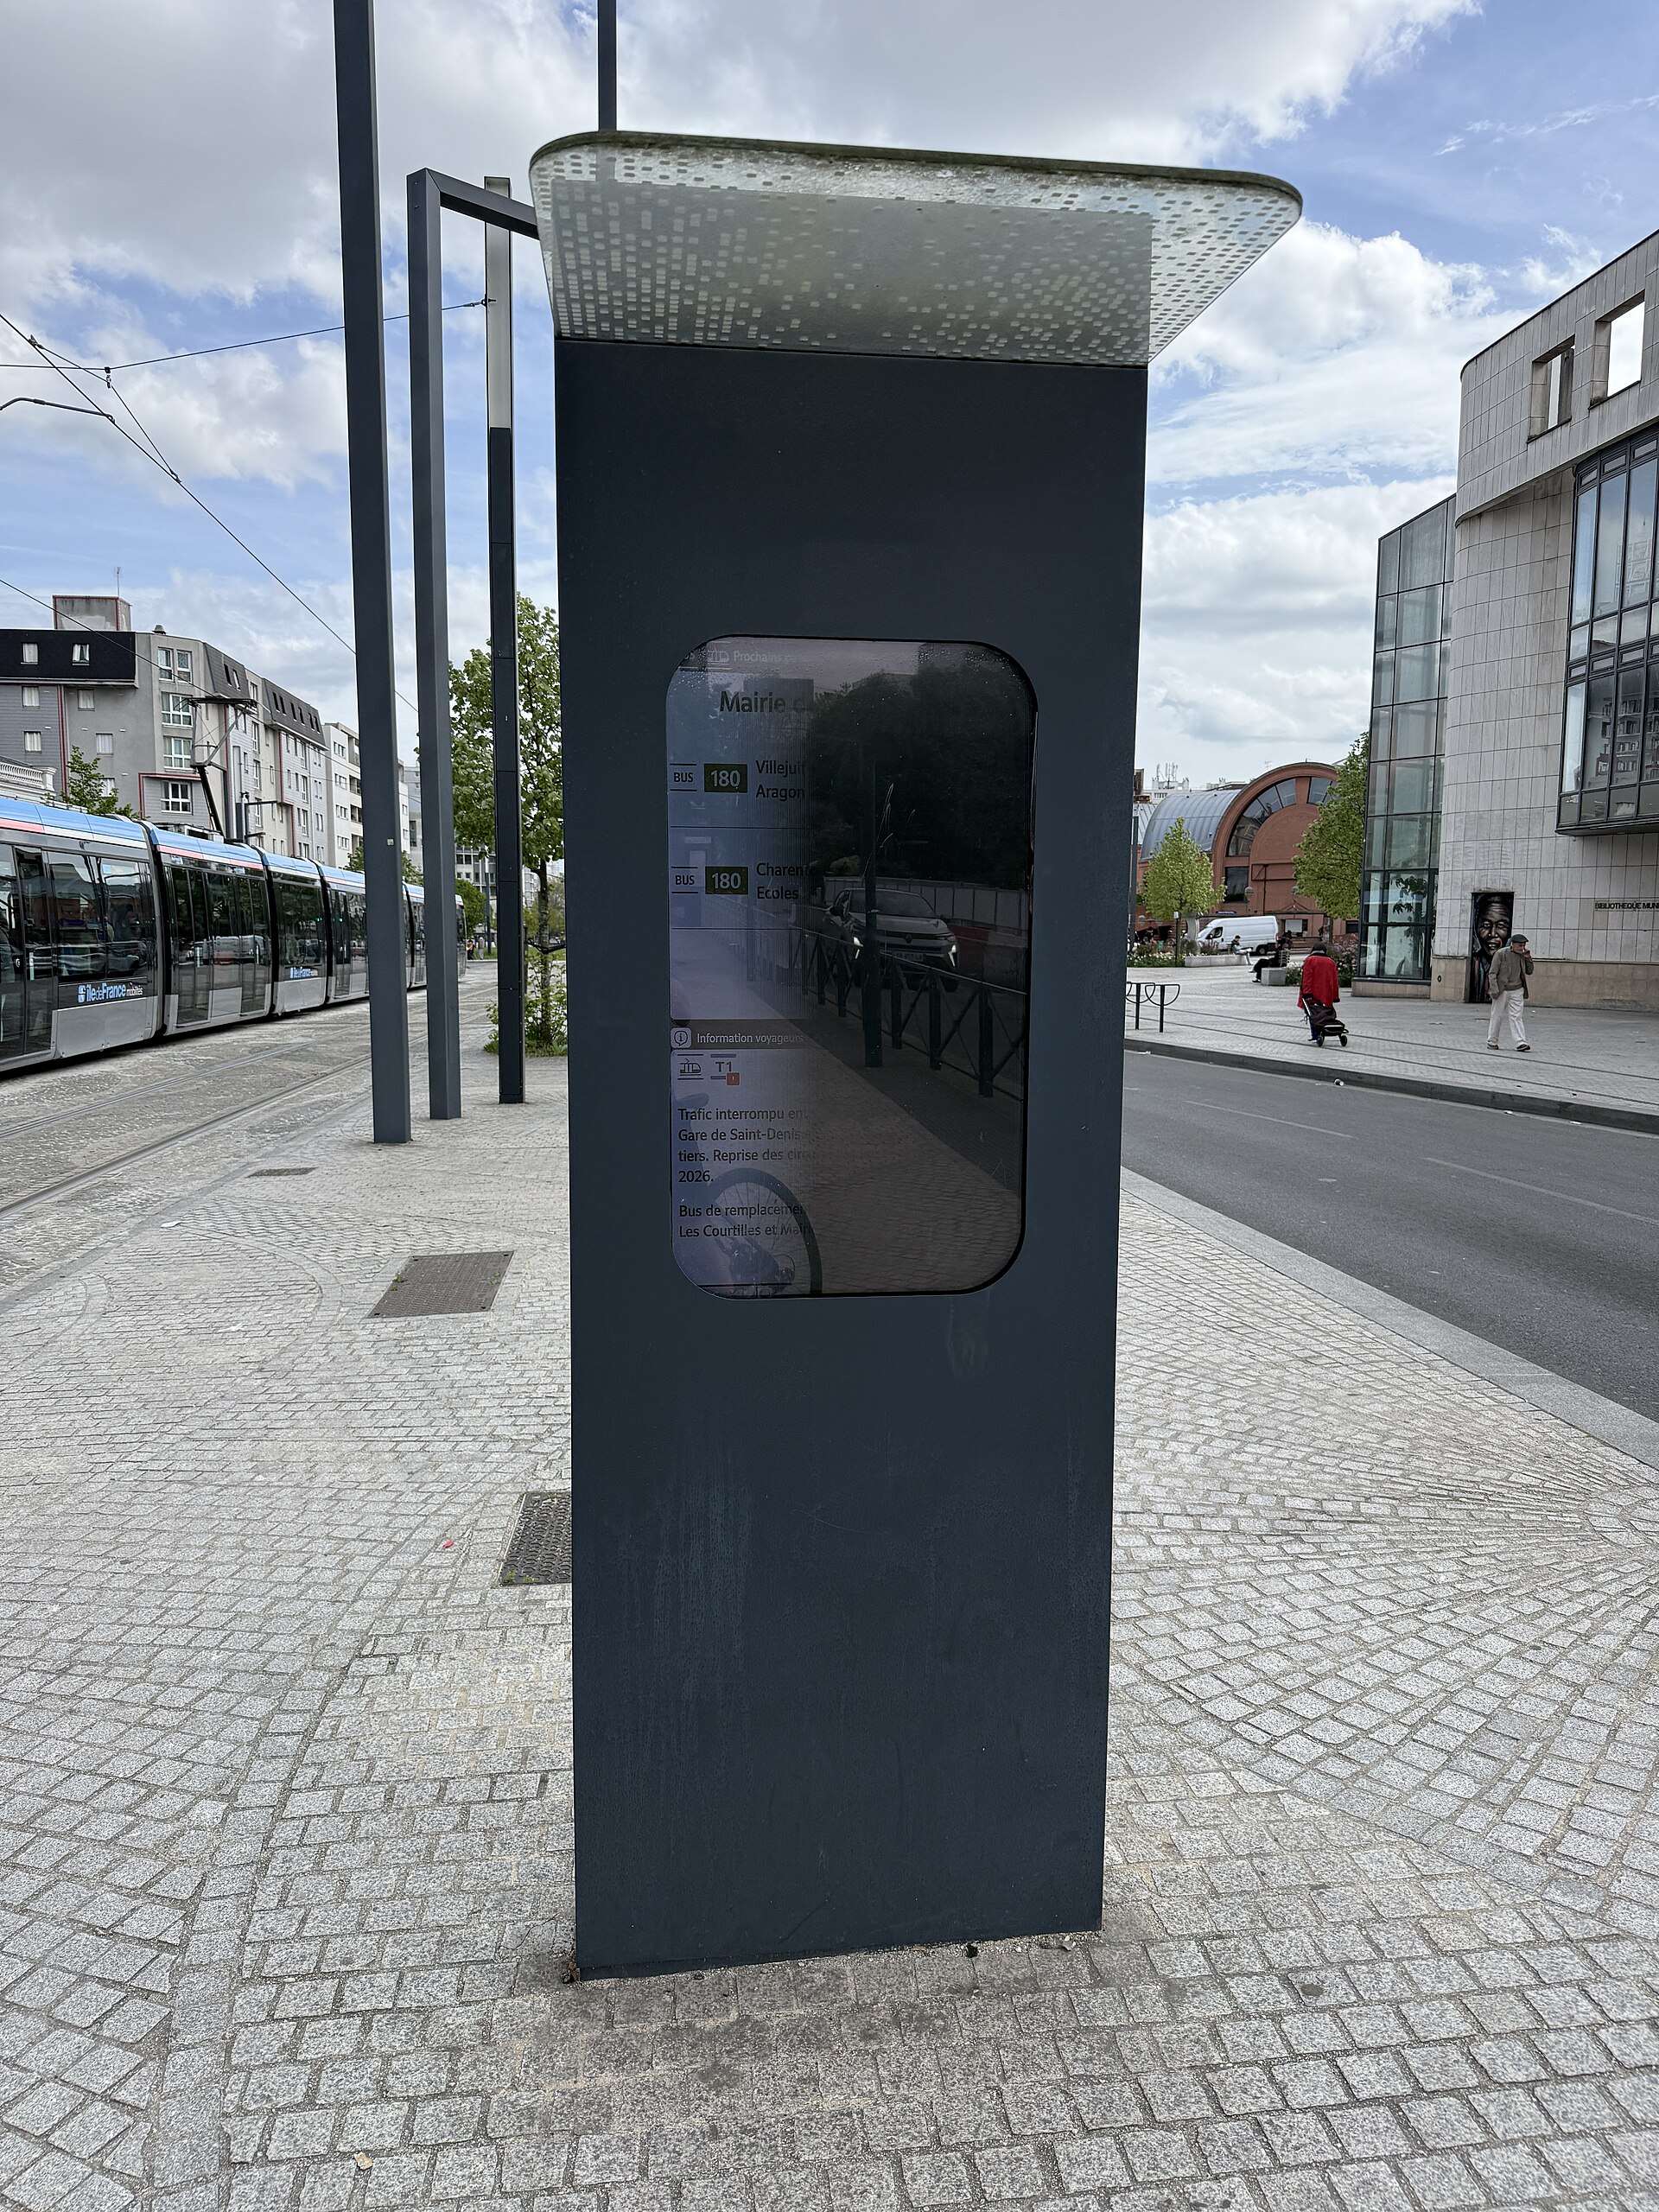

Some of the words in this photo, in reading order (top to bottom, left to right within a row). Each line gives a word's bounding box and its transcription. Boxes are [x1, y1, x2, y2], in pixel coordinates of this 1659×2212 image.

[720, 690, 785, 713] Mairie
[673, 772, 694, 783] BUS
[710, 770, 741, 787] 180
[755, 784, 805, 801] Aragon
[675, 875, 695, 885] BUS
[712, 873, 741, 888] 180
[757, 887, 799, 899] Ecoles
[697, 1033, 753, 1043] Information
[755, 1034, 804, 1045] voyageurs
[678, 1108, 712, 1120] Trafic
[716, 1108, 785, 1122] interrompu
[678, 1128, 708, 1141] Gare
[711, 1128, 727, 1141] de
[678, 1149, 709, 1161] tiers.
[714, 1149, 759, 1164] Reprise
[762, 1148, 783, 1160] des
[678, 1170, 714, 1183] 2026.
[679, 1205, 702, 1217] Bus
[706, 1205, 721, 1216] de
[679, 1225, 699, 1237] Les
[703, 1224, 760, 1236] Courtilles
[765, 1224, 777, 1236] et
